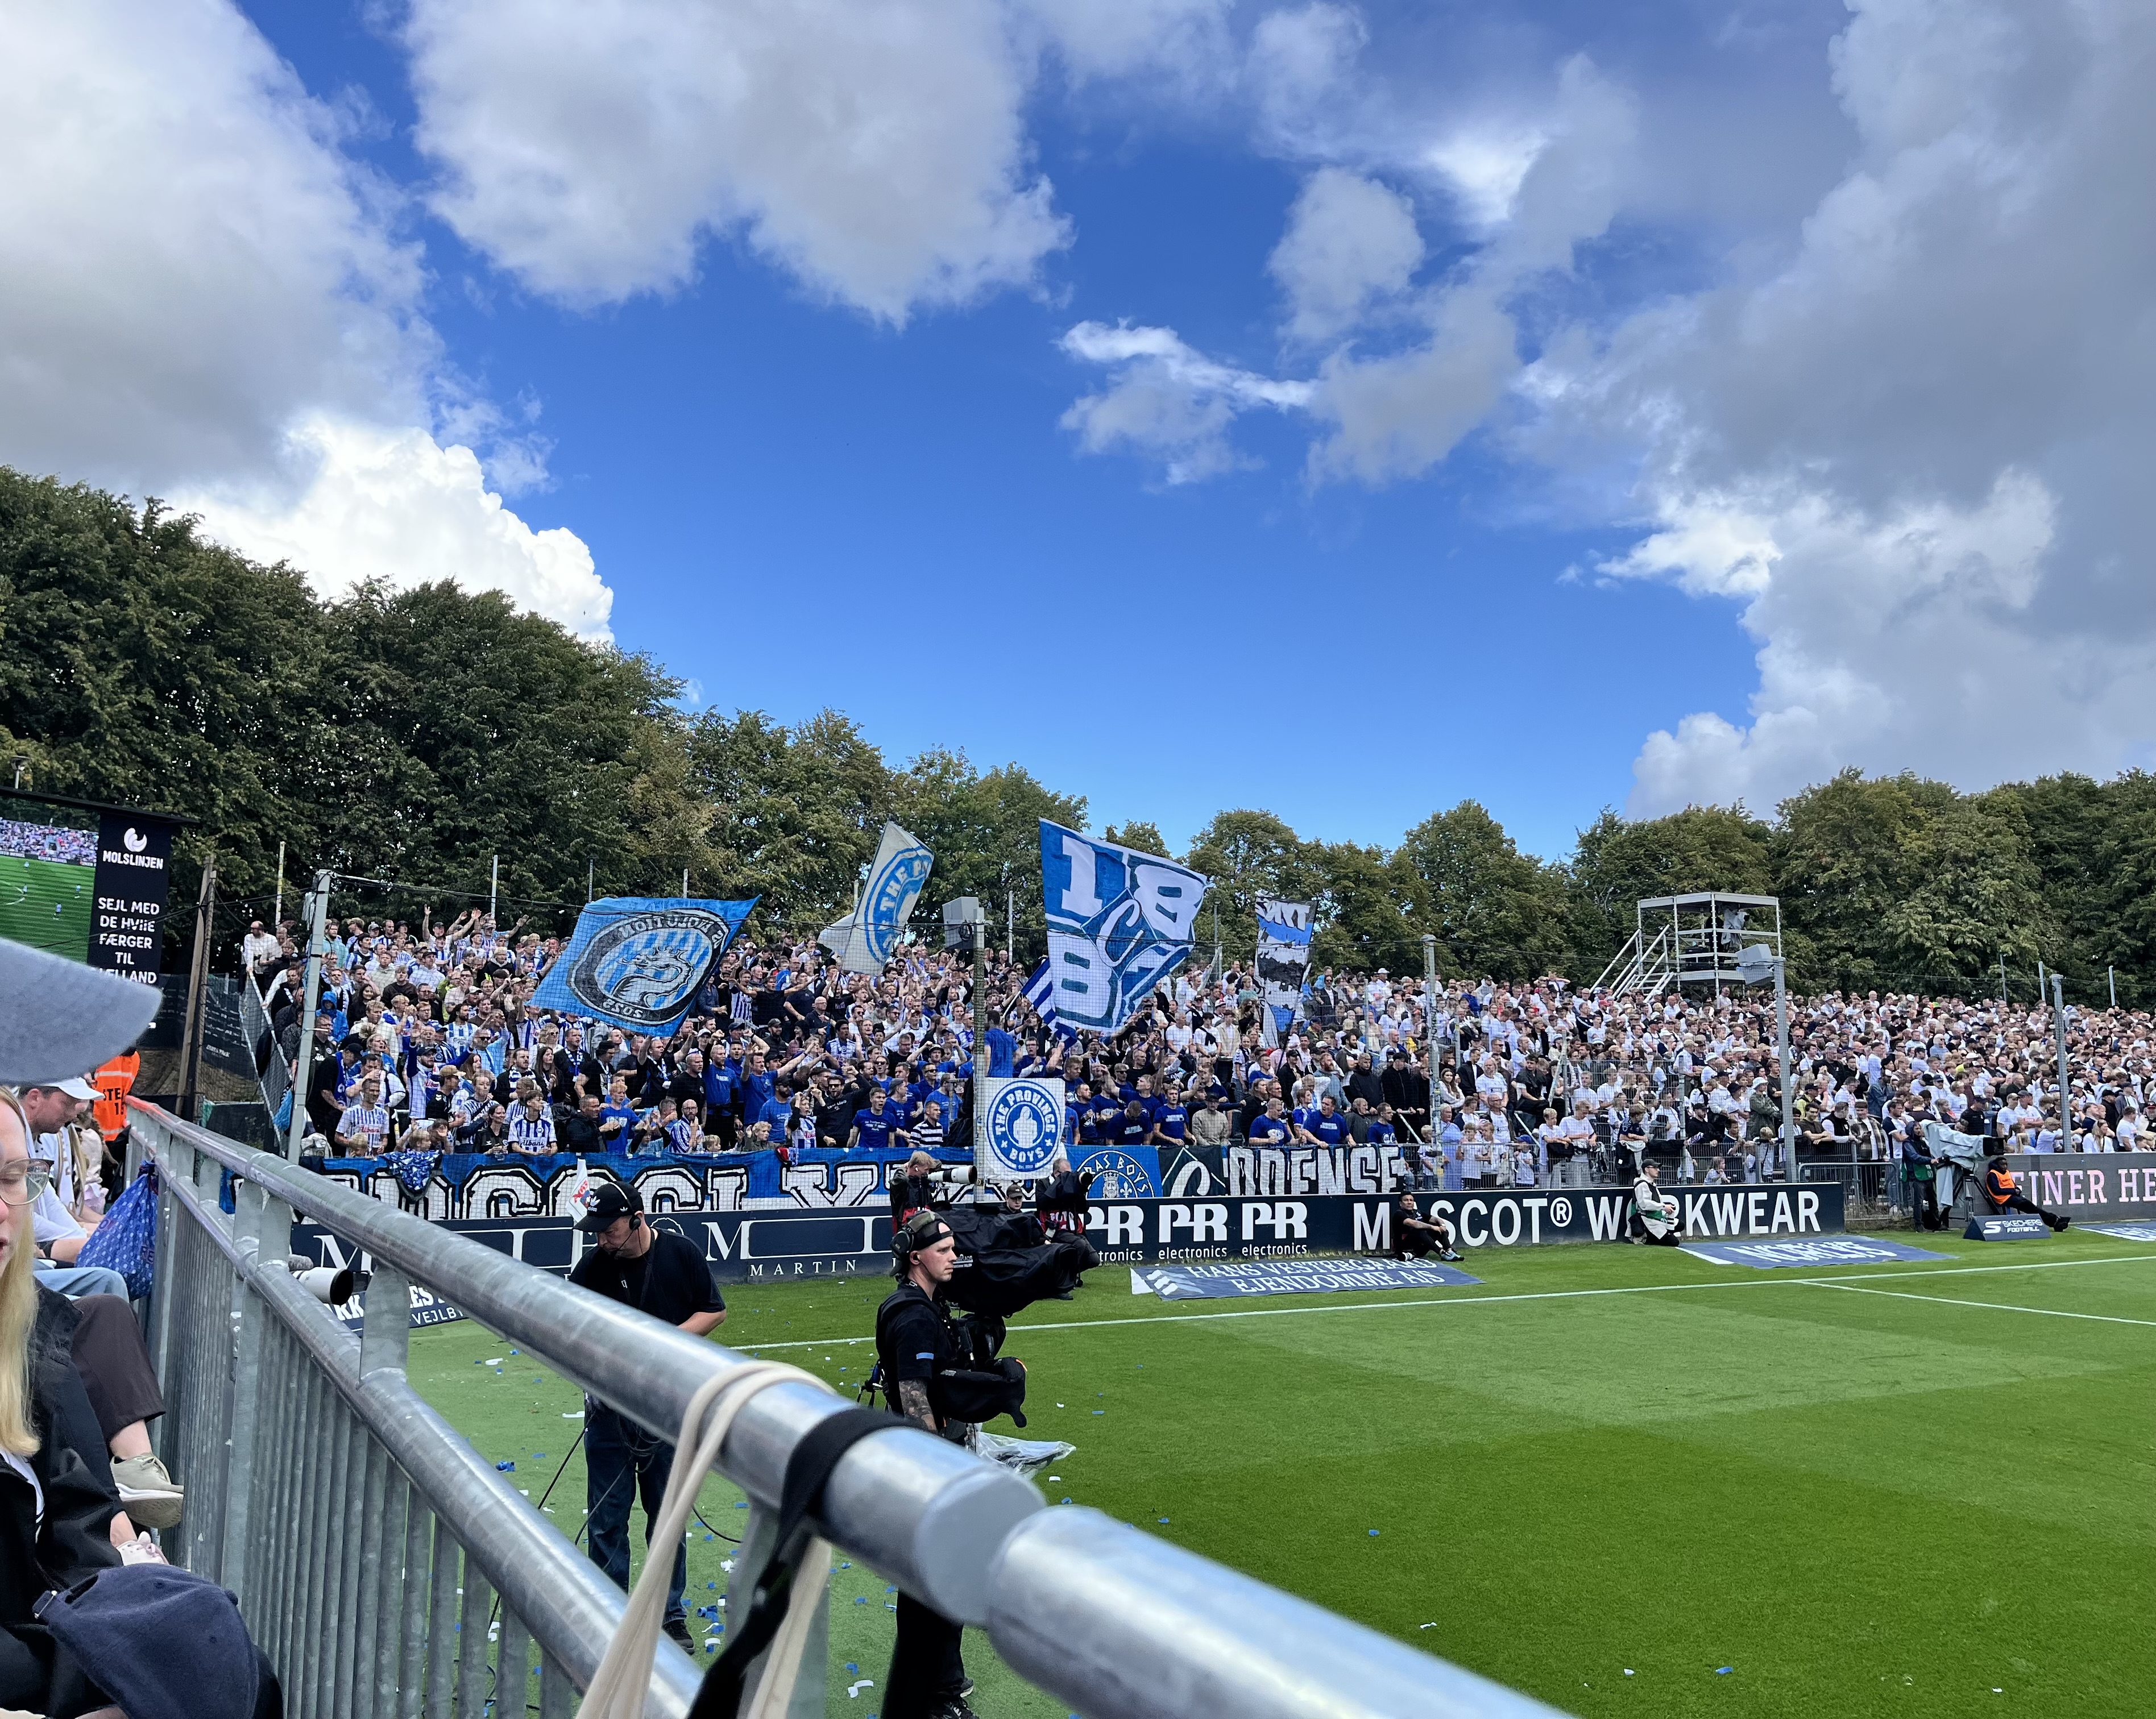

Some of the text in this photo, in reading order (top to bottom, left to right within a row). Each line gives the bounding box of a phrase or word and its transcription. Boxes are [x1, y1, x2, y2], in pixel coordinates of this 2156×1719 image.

[102, 850, 164, 870] MOLSLINJEN
[880, 866, 908, 911] THE
[98, 897, 160, 915] SEJL MED
[99, 915, 118, 928] DE
[99, 933, 152, 950] FÆRGER
[115, 952, 135, 965] TIL
[995, 1089, 1056, 1135] THE PROVINCE
[1009, 1147, 1044, 1162] BOYS
[1117, 1156, 1149, 1193] BOYS
[1159, 1203, 1228, 1243] PR
[1242, 1202, 1308, 1240] PR
[1353, 1197, 1573, 1251] MSCOT®
[1585, 1190, 1821, 1242] WRKWEAR
[2002, 1219, 2043, 1228] SKECHERS
[1098, 1248, 1143, 1263] tronics
[1158, 1245, 1228, 1260] electronics
[1242, 1242, 1308, 1257] electronics
[1723, 1241, 1898, 1263] NORLYS
[749, 1259, 856, 1277] MARTIN
[1184, 1257, 1437, 1278] HANS VESTERGAARD
[1229, 1269, 1446, 1293] EJENDOMME A/S
